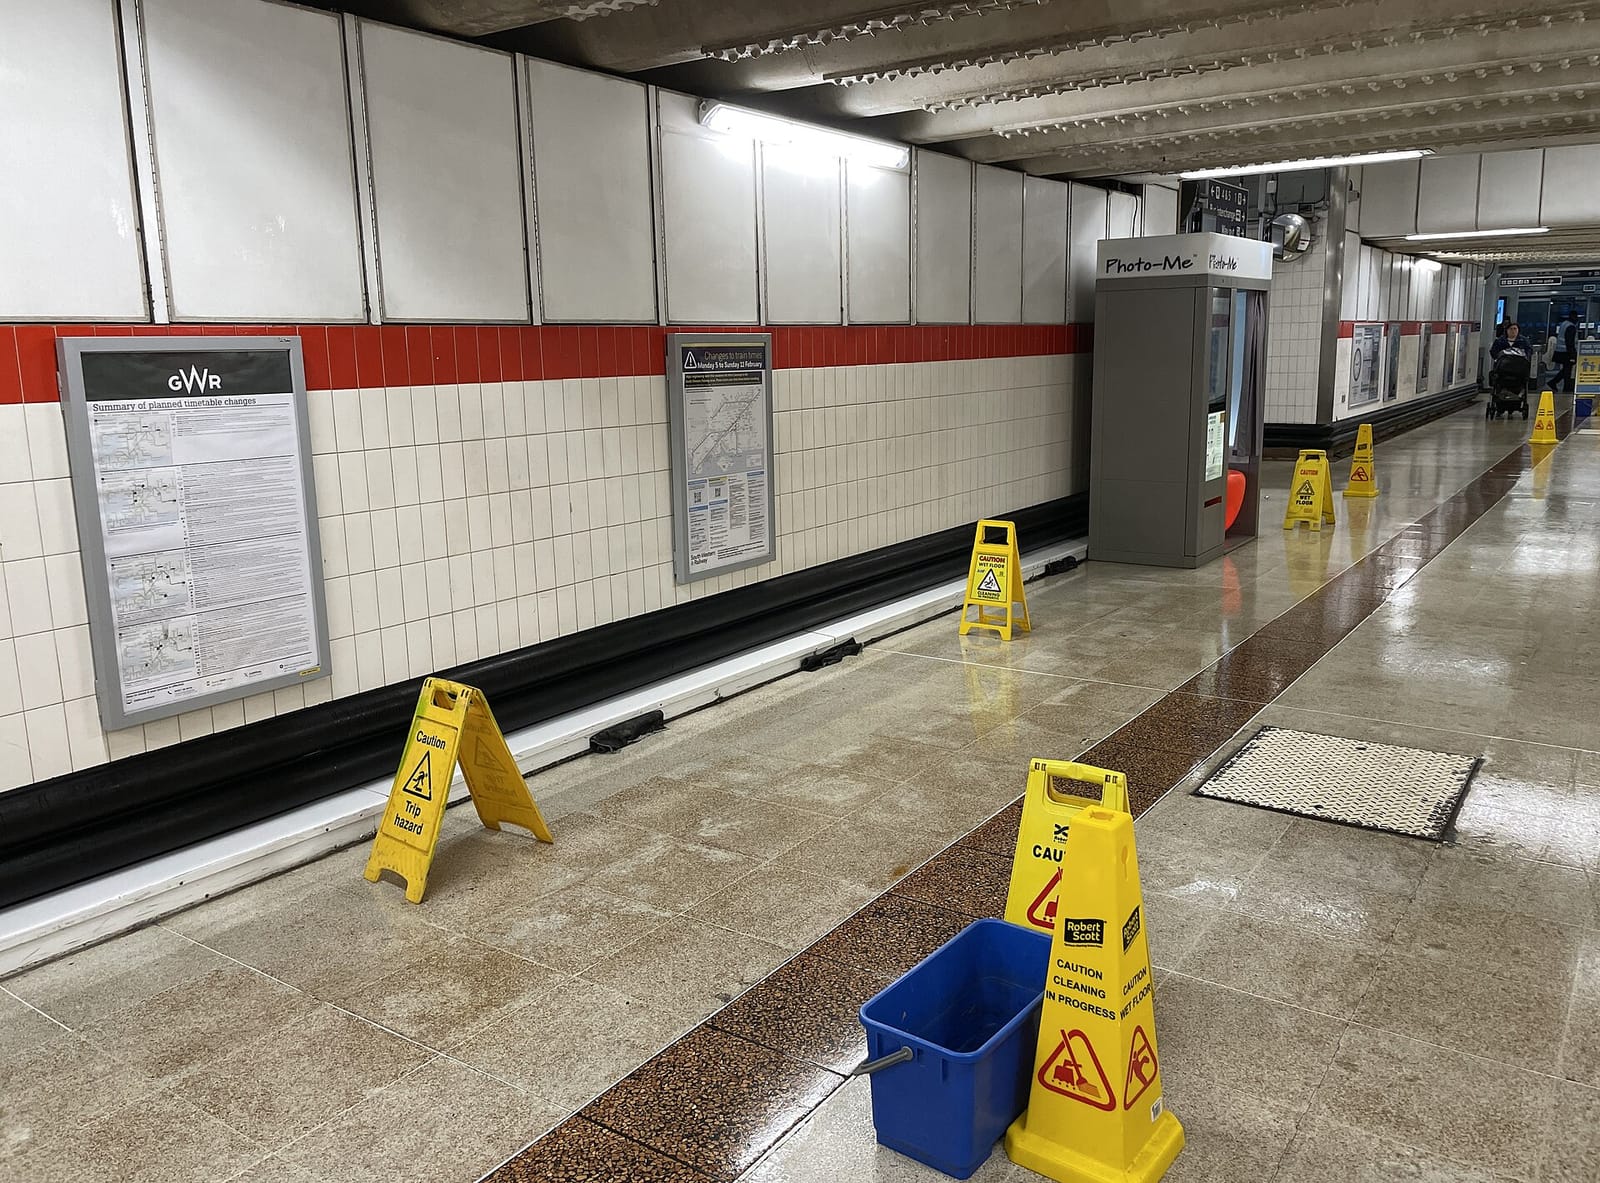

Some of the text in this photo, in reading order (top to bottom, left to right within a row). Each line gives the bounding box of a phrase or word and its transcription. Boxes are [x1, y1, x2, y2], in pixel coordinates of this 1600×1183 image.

[1105, 255, 1193, 273] Photo-Me
[1208, 254, 1237, 271] Photo-Me
[704, 352, 729, 362] Changes
[729, 352, 735, 360] to
[735, 352, 748, 360] train
[724, 361, 740, 369] Sunday
[745, 360, 762, 368] February
[168, 364, 222, 394] GWR
[92, 397, 257, 412] Summary of planned timetable changes
[979, 555, 1005, 563] CAUTION
[416, 730, 446, 750] Caution
[405, 800, 421, 819] Trip
[393, 813, 424, 836] hazard
[1033, 845, 1066, 862] CAU
[1067, 921, 1101, 932] Robert
[1072, 932, 1100, 941] Scott
[1056, 958, 1103, 980] CAUTION
[1053, 975, 1106, 999] CLEANING
[1122, 966, 1147, 996] CAUTION
[1045, 990, 1116, 1020] IN PROGRESS
[1120, 983, 1151, 1020] WET FLOOR
